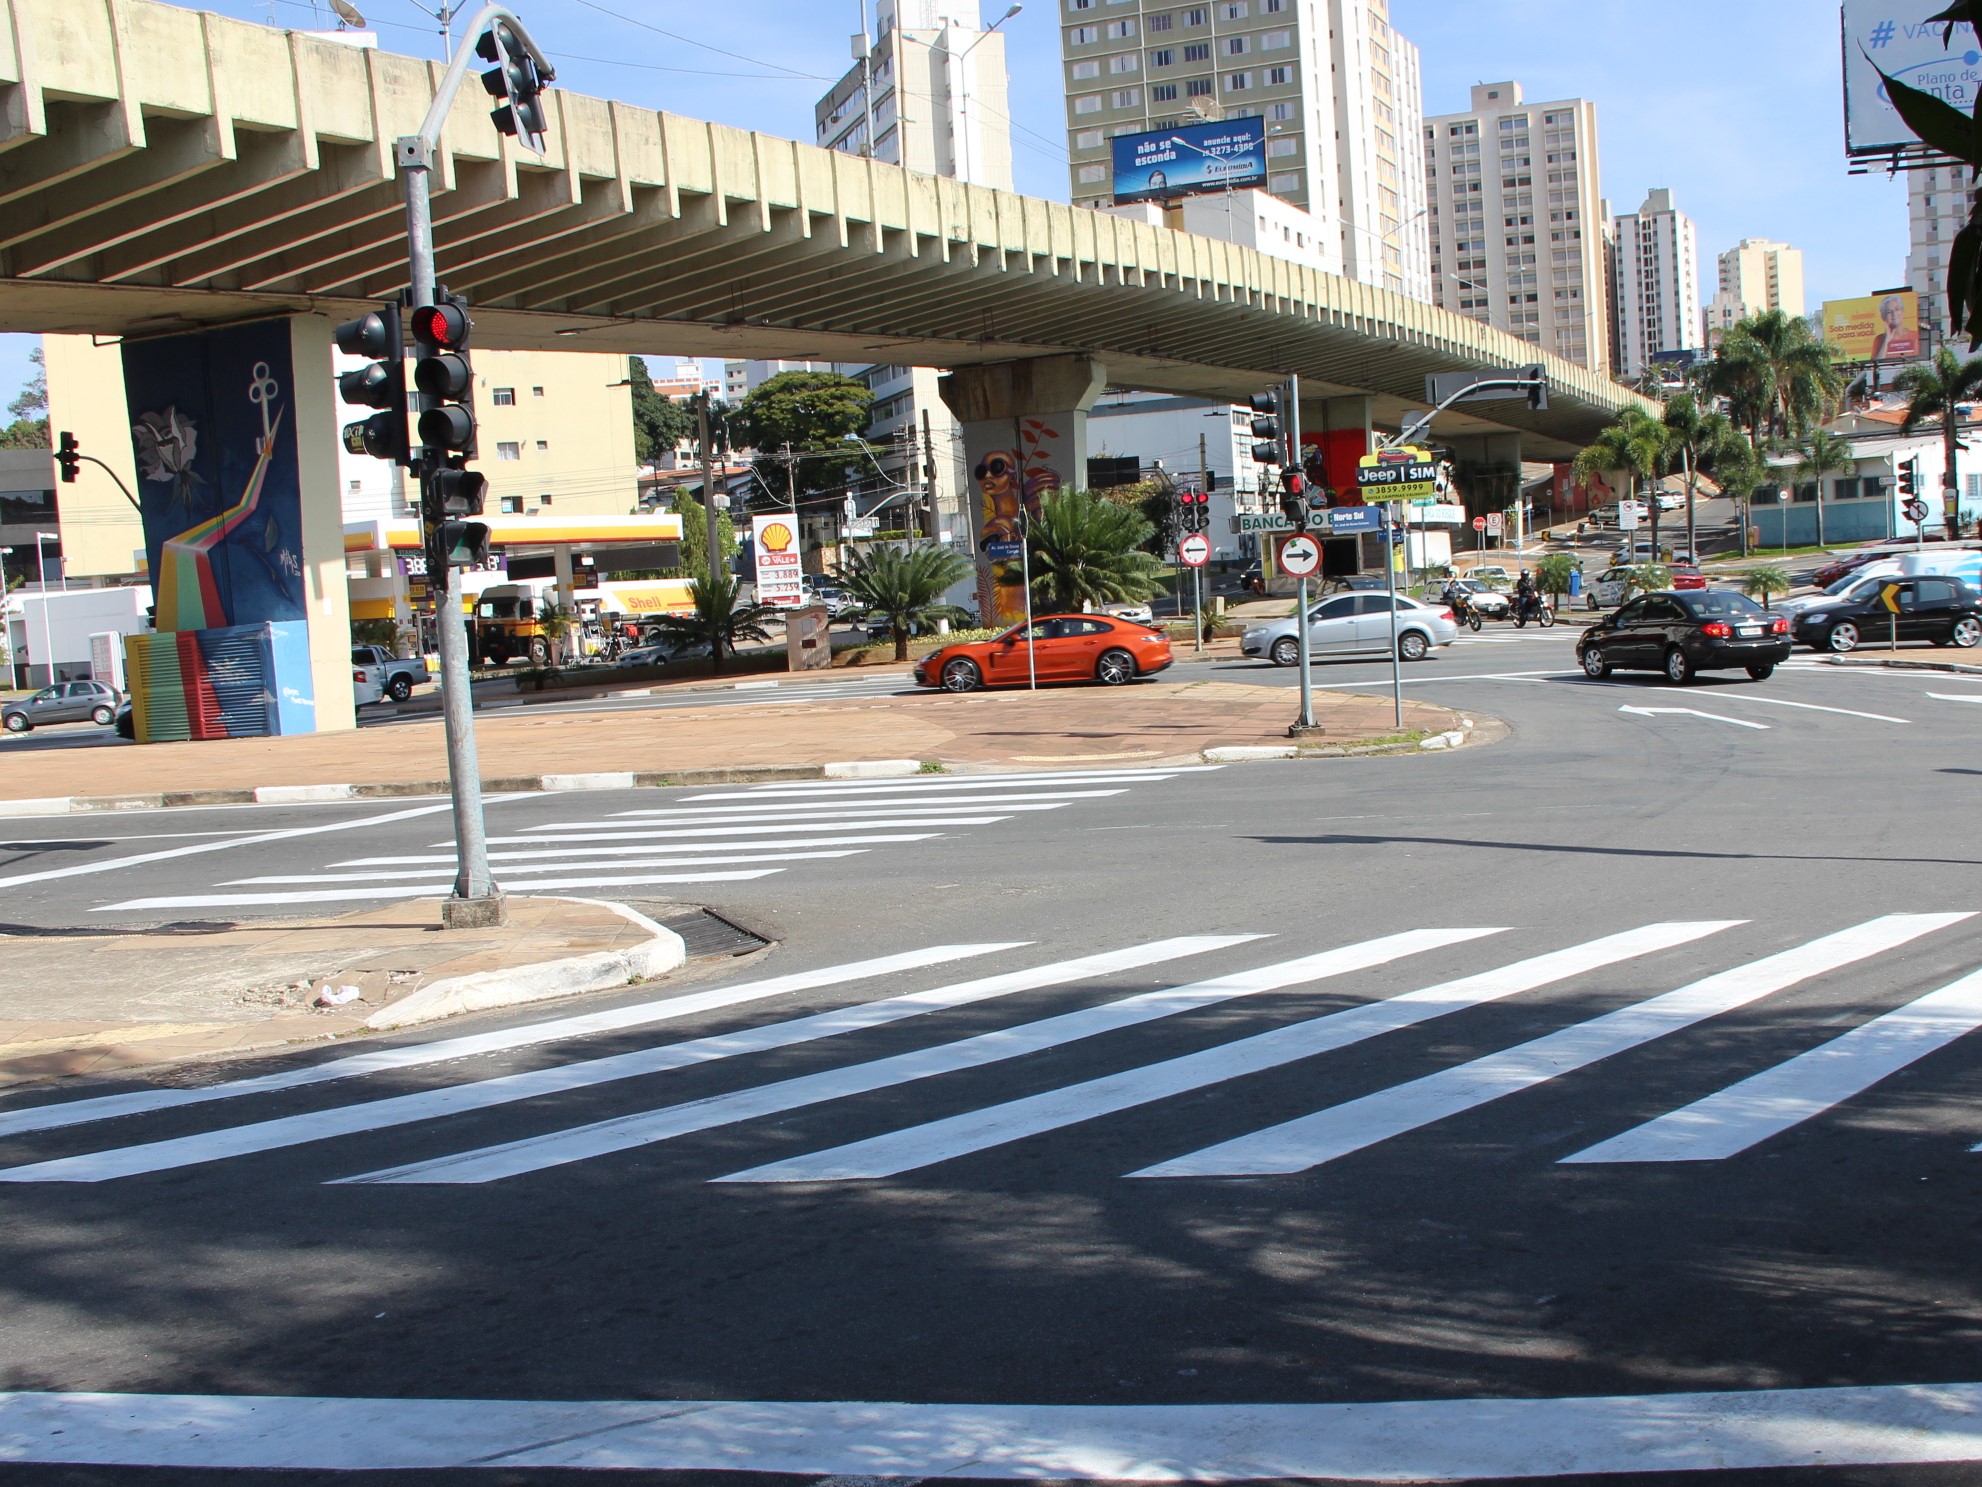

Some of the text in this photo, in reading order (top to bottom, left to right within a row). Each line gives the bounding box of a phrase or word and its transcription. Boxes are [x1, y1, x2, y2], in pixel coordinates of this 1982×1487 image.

[1918, 70, 1978, 86] Plano de
[1137, 140, 1171, 154] não se
[1135, 149, 1176, 167] esconda
[1829, 322, 1875, 333] Sob medida
[1358, 466, 1436, 483] Jeep SIM
[1375, 483, 1424, 495] 3859.9999
[1333, 513, 1352, 522] Norte
[1353, 512, 1364, 520] Sul
[628, 596, 661, 609] Shell
